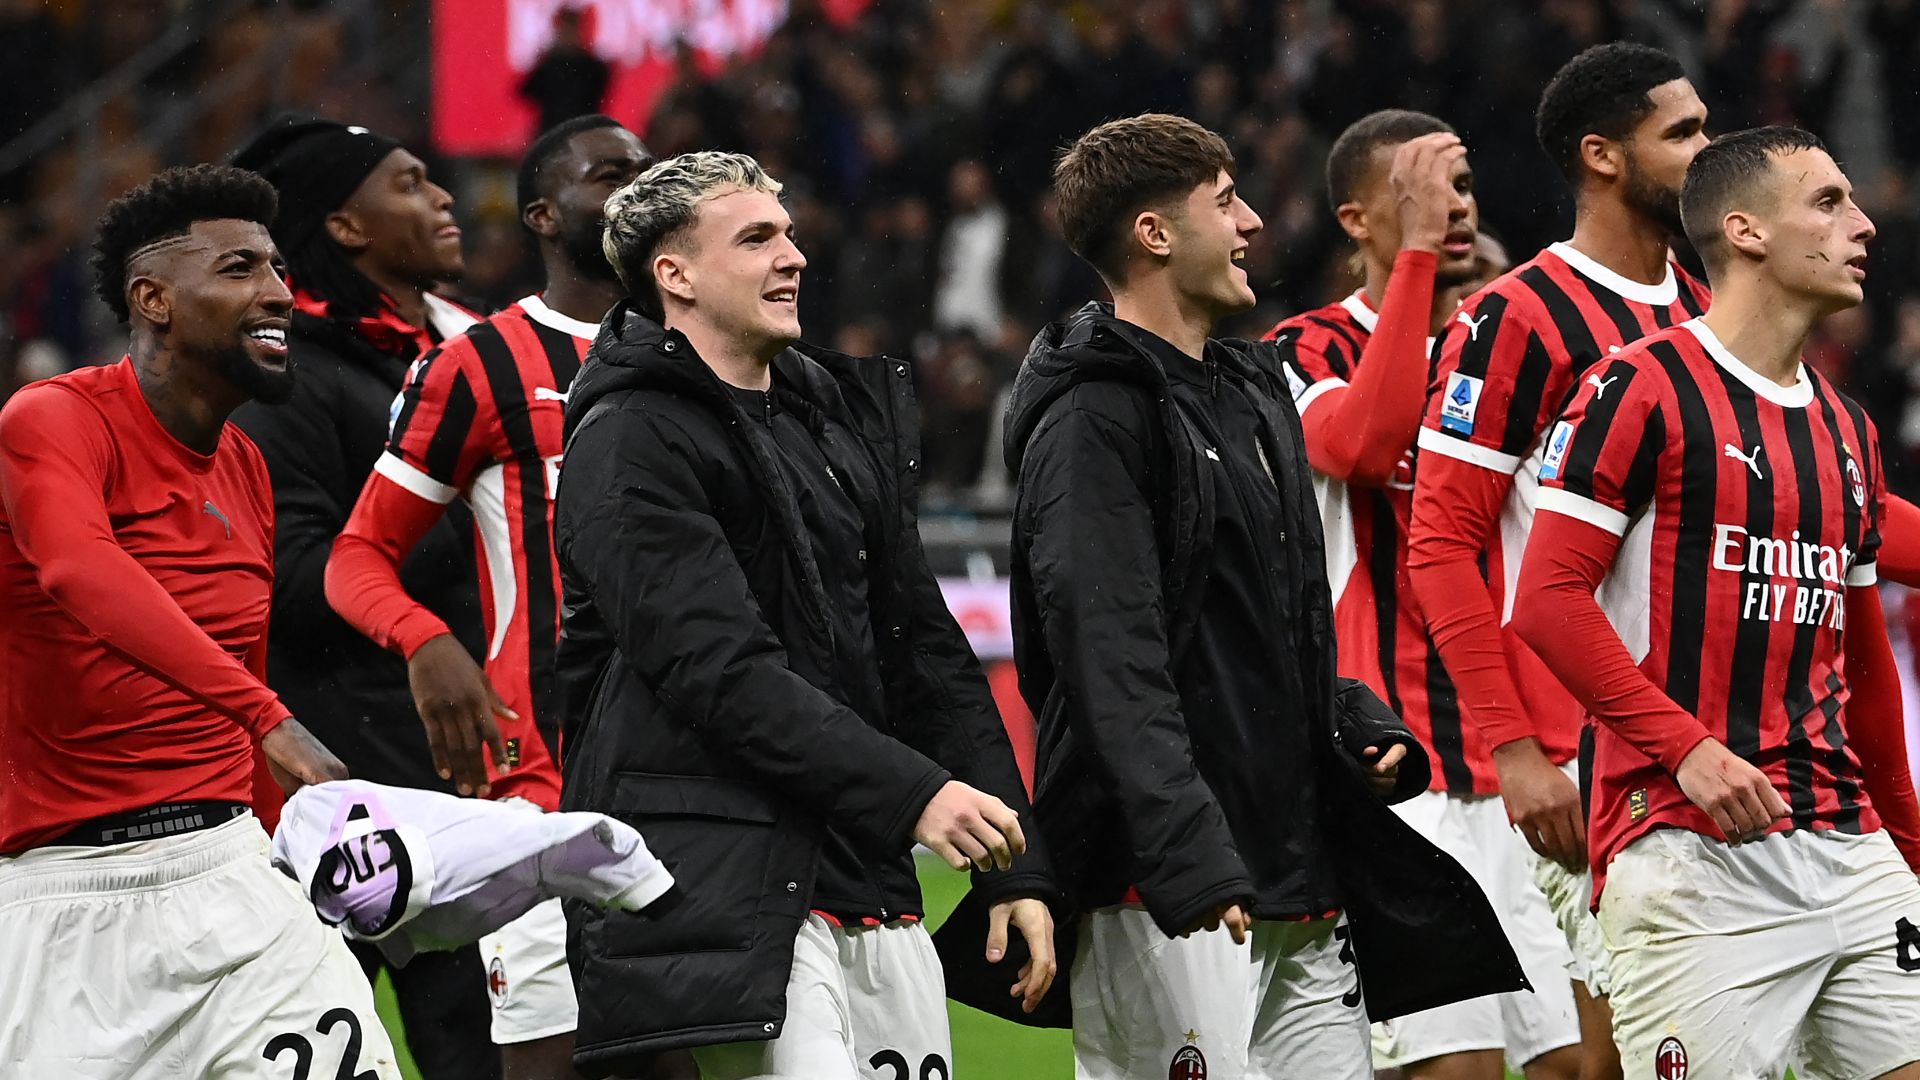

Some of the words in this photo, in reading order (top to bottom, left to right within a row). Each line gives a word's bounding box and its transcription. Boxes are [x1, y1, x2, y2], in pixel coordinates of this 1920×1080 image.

[1711, 523, 1855, 587] Emirat
[1743, 582, 1787, 622] FLY
[1792, 586, 1845, 632] BET
[262, 1007, 379, 1080] 22
